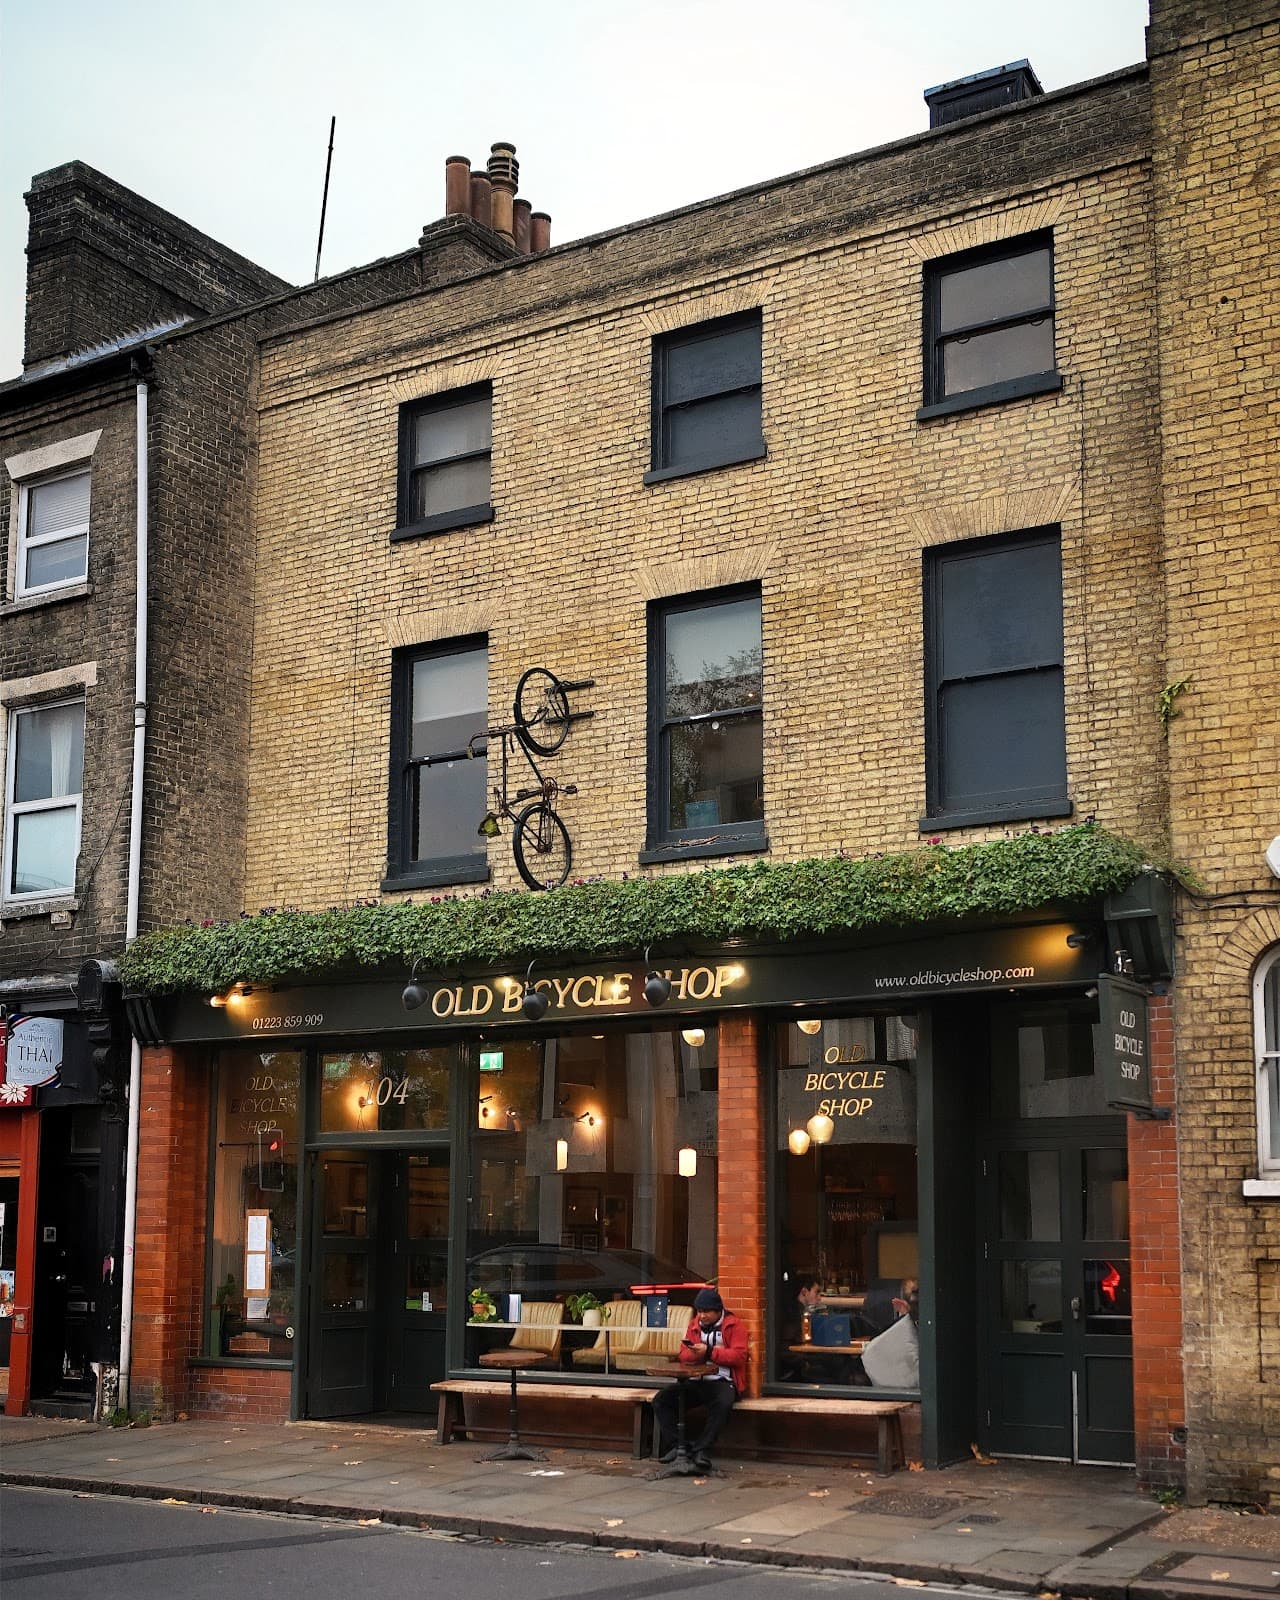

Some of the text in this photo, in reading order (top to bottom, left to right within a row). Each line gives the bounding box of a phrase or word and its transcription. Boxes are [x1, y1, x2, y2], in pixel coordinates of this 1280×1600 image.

[874, 966, 1035, 988] www.oldbicycleshop.com
[431, 985, 494, 1017] OLD
[642, 965, 744, 1001] HOP
[252, 1013, 324, 1030] 01223 859 909
[1120, 1010, 1136, 1028] OLD
[17, 1045, 53, 1063] THAI
[824, 1045, 865, 1064] OLD
[1114, 1033, 1144, 1056] BICYCLE
[804, 1070, 887, 1091] BICYCLE
[1121, 1061, 1141, 1081] SHOP
[246, 1076, 273, 1091] OLD
[366, 1075, 411, 1106] 104
[818, 1097, 873, 1117] SHOP
[240, 1120, 277, 1135] SHOP
